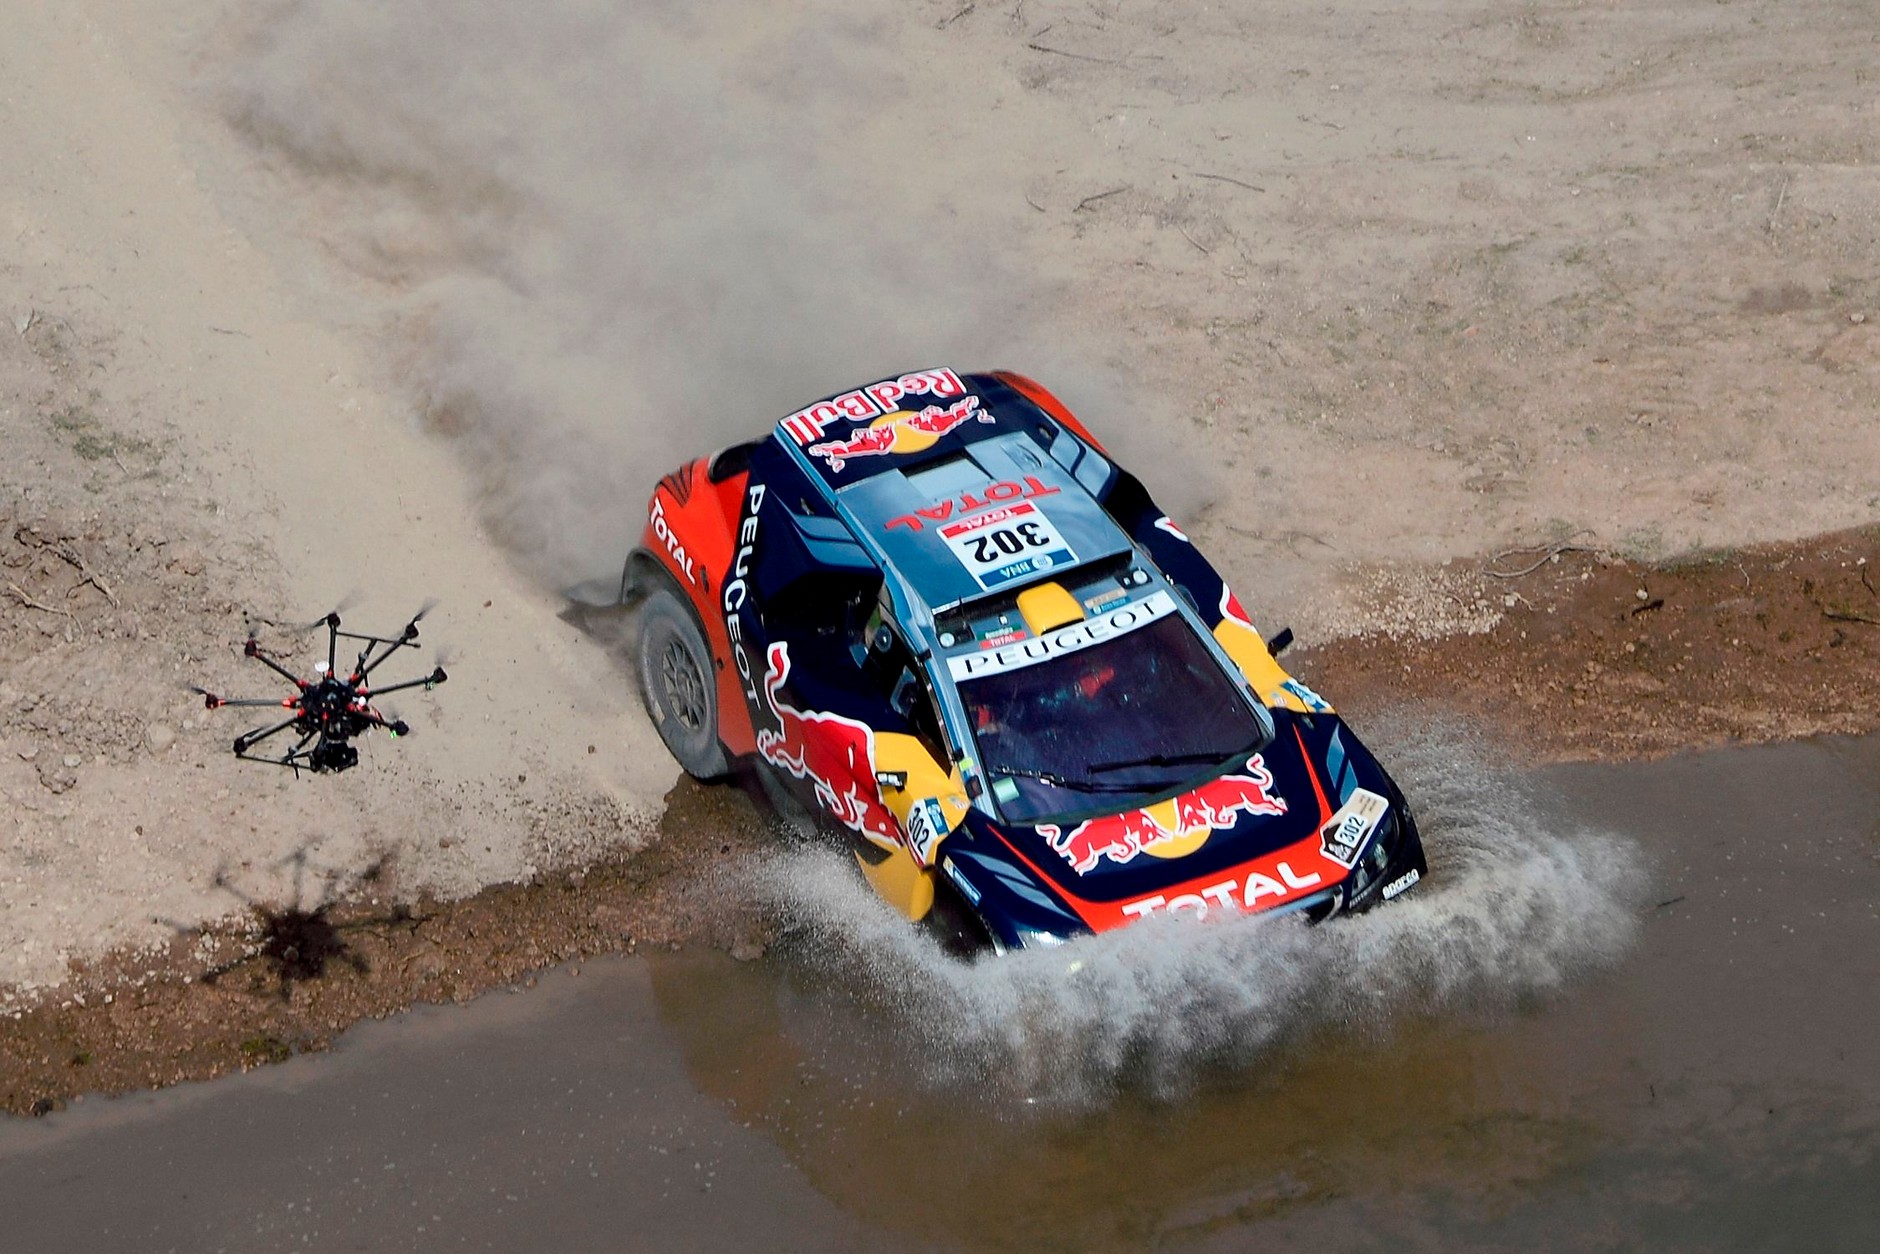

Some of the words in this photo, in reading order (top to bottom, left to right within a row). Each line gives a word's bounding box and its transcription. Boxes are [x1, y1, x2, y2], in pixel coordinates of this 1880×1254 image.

[866, 367, 966, 412] Red
[779, 389, 878, 446] Bull
[884, 476, 1061, 531] TOTAL
[960, 509, 1017, 530] TOTAL
[650, 498, 695, 584] TOTAL
[964, 522, 1049, 563] 302
[725, 484, 765, 709] PEUGEOT
[965, 596, 1154, 673] PEUGEOT
[909, 807, 930, 857] 302
[1340, 816, 1364, 843] 302
